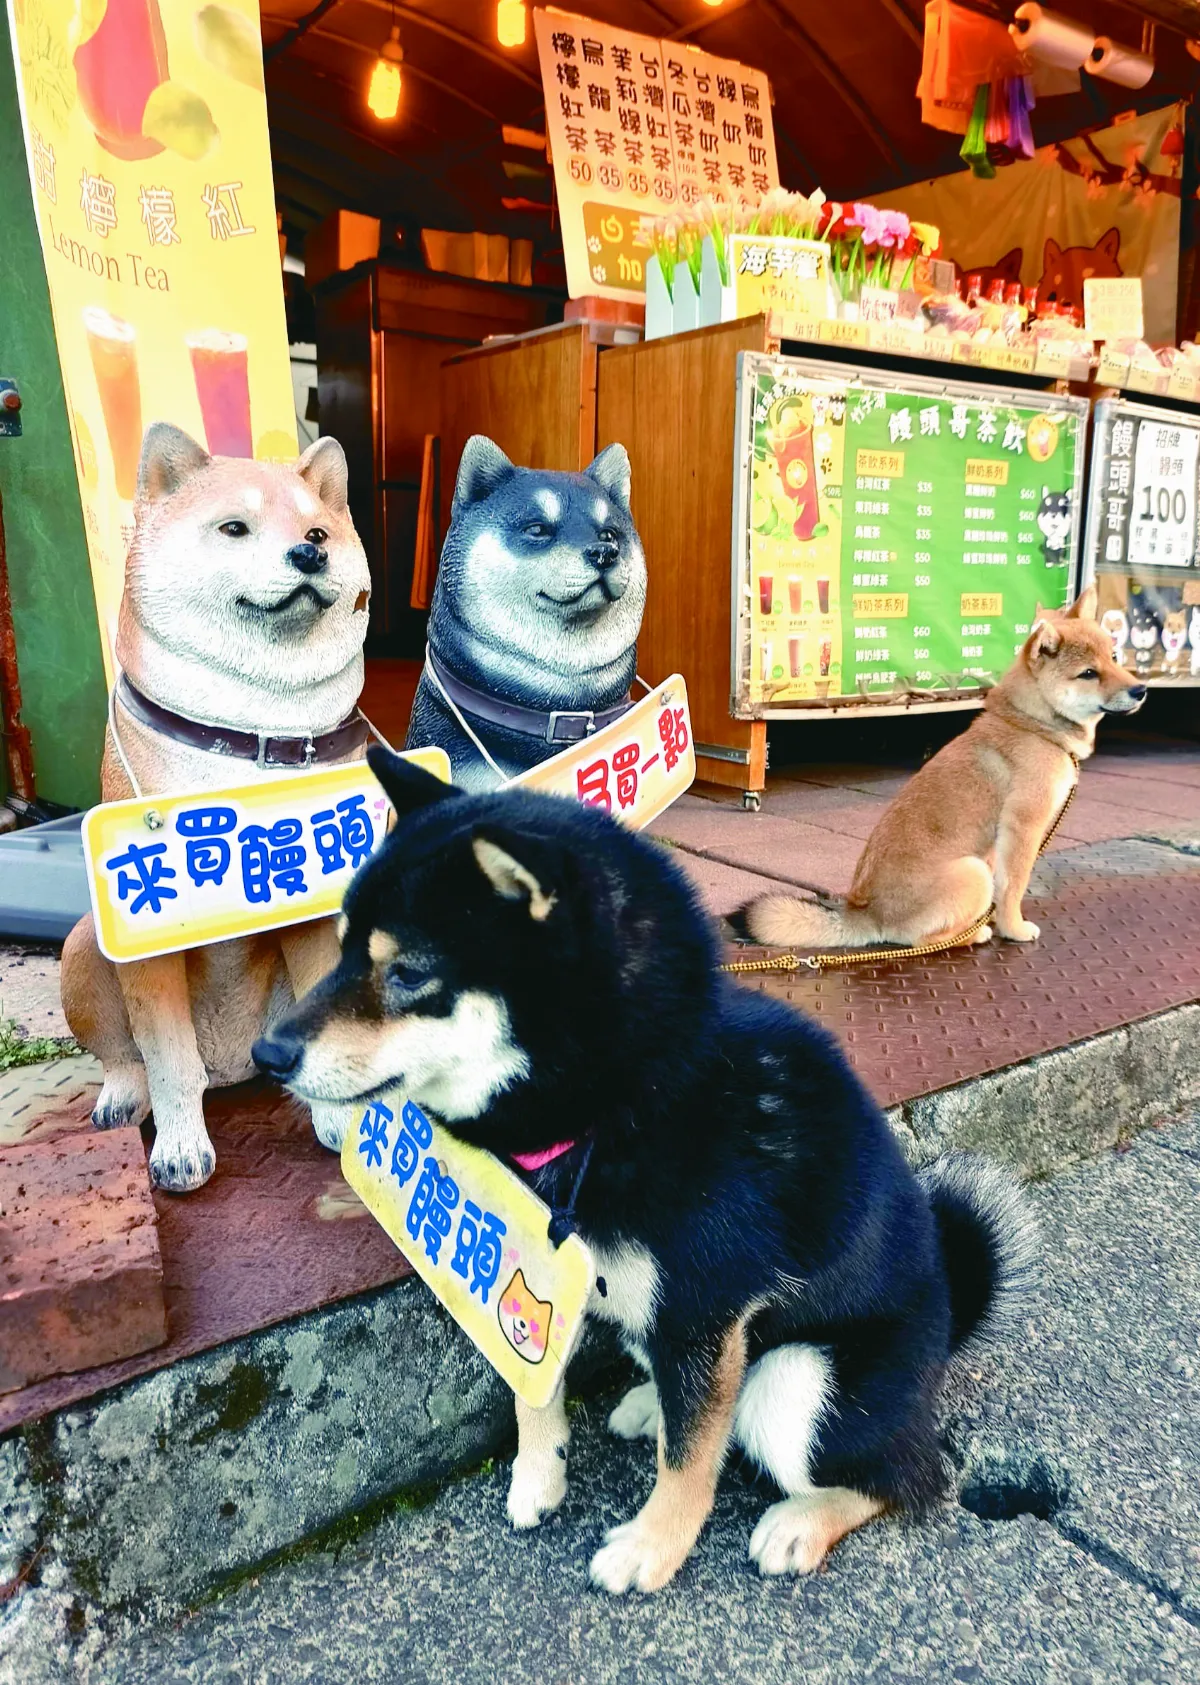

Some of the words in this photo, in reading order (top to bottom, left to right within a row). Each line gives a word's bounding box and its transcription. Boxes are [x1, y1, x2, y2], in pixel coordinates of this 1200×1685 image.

[580, 38, 616, 156] 烏龍茶
[640, 52, 672, 172] 台灣紅茶
[569, 160, 592, 181] 50
[599, 164, 621, 186] 35
[628, 171, 649, 193] 35
[654, 176, 674, 199] 35
[680, 183, 700, 204] 35
[49, 214, 121, 283] Lemon
[126, 253, 170, 292] Tea
[888, 404, 1026, 455] 饅頭哥茶飲
[858, 455, 899, 472] 茶飲系列
[1106, 420, 1134, 531] 饅頭哥
[917, 481, 933, 493] $35
[1020, 488, 1036, 500] $60
[916, 505, 933, 516] $35
[1140, 485, 1187, 525] 100
[1018, 510, 1034, 521] $60
[915, 528, 931, 540] $35
[1017, 532, 1033, 543] $65
[914, 552, 930, 563] $50
[1016, 553, 1031, 565] $65
[914, 575, 931, 587] $50
[854, 598, 905, 612] 鮮奶茶系列
[961, 598, 998, 611] 奶茶系列
[913, 625, 931, 637] $60
[914, 648, 930, 660] $60
[916, 670, 932, 682] $60
[106, 794, 373, 915] 來買饅頭
[359, 1099, 507, 1304] 來買饅頭
